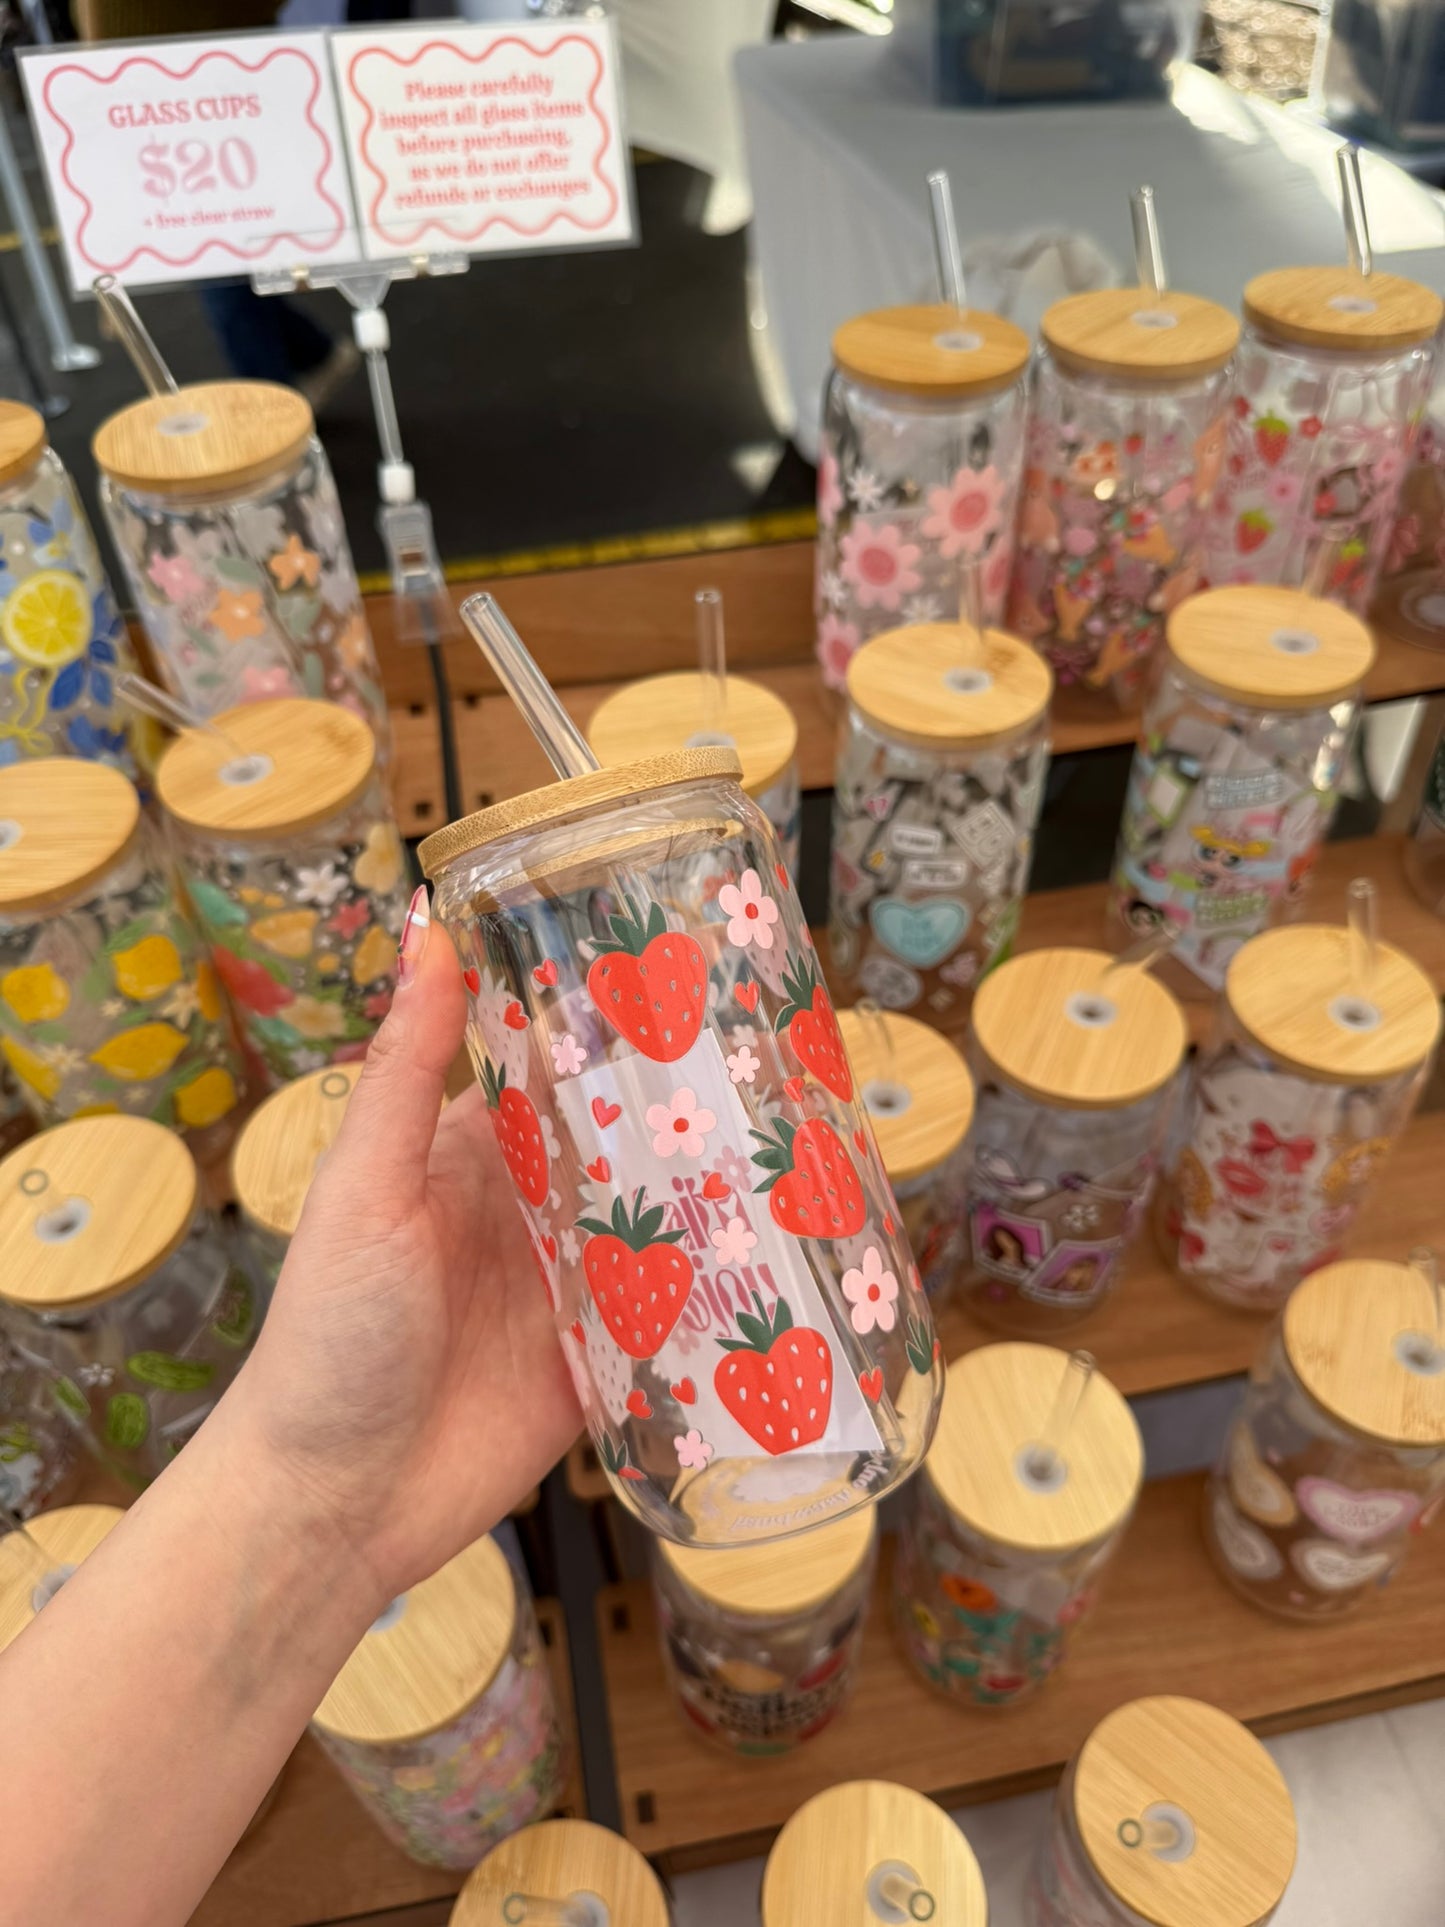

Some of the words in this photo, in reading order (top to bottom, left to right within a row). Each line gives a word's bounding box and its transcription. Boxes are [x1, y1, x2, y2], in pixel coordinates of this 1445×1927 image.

[405, 80, 466, 101] Please
[470, 73, 553, 96] carefully
[107, 99, 192, 129] GLASS
[195, 93, 262, 121] CUPS
[379, 107, 448, 131] inspect
[453, 104, 476, 124] all
[481, 102, 528, 127] glass
[532, 100, 584, 119] items
[396, 134, 457, 156] before
[138, 132, 257, 206] $20
[410, 166, 430, 180] as
[434, 164, 459, 179] we
[465, 159, 486, 176] do
[492, 158, 521, 175] not
[525, 151, 569, 172] offer
[396, 187, 467, 209] refunds
[473, 187, 491, 201] or
[191, 208, 226, 225] clear
[232, 205, 275, 221] straw
